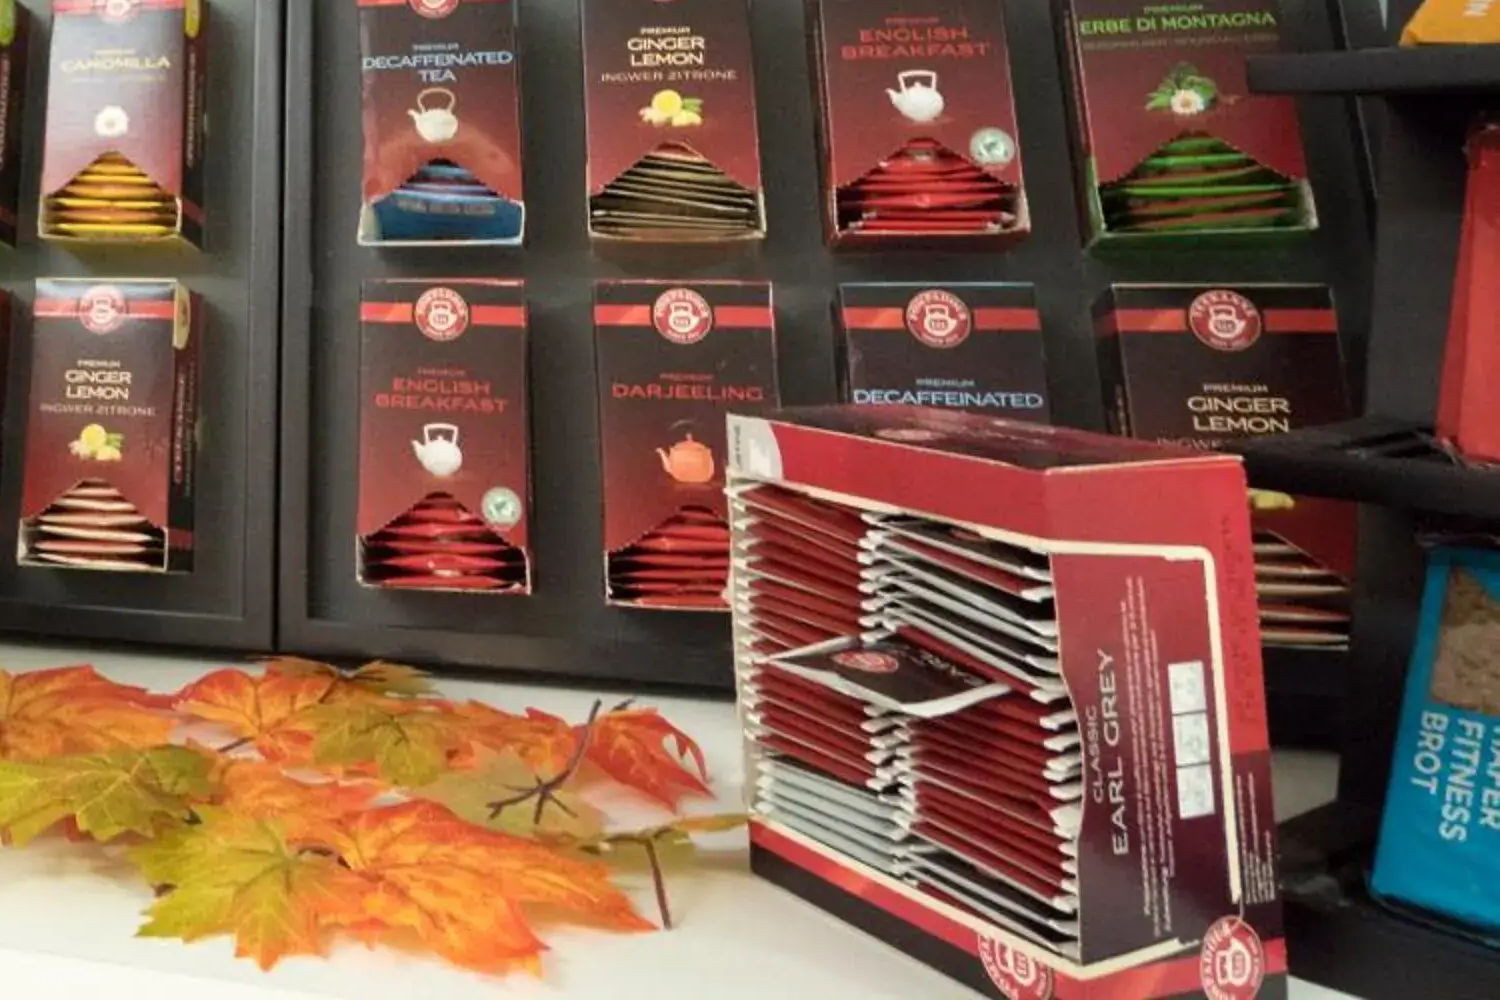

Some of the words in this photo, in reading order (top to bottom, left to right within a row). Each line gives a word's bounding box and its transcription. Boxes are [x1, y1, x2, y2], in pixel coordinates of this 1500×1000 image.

[1079, 19, 1131, 36] ERBE
[1136, 17, 1158, 33] DI
[1162, 11, 1278, 31] MONTAGNA
[626, 37, 706, 51] GINGER
[859, 27, 969, 44] ENGLISH
[362, 50, 514, 70] DECAFFEINATED
[630, 51, 704, 67] LEMON
[841, 42, 989, 60] BREAKFAST
[418, 69, 457, 83] TEA
[601, 71, 663, 83] INGWER
[667, 69, 737, 82] ZITRONE
[64, 371, 132, 385] GINGER
[392, 377, 490, 396] ENGLISH
[915, 378, 975, 387] PREMIUM
[65, 385, 130, 401] LEMON
[612, 382, 764, 401] DARJEELING
[1202, 383, 1269, 394] PREMIUM
[375, 394, 508, 414] BREAKFAST
[853, 389, 1043, 408] DECAFFEINATED
[1187, 396, 1291, 414] GINGER
[1192, 414, 1290, 433] LEMON
[1097, 648, 1120, 747] GREY
[1085, 704, 1103, 804] CLASSIC
[1410, 710, 1449, 796] BROT
[1438, 717, 1486, 842] FITNESS
[1108, 756, 1129, 856] EARL
